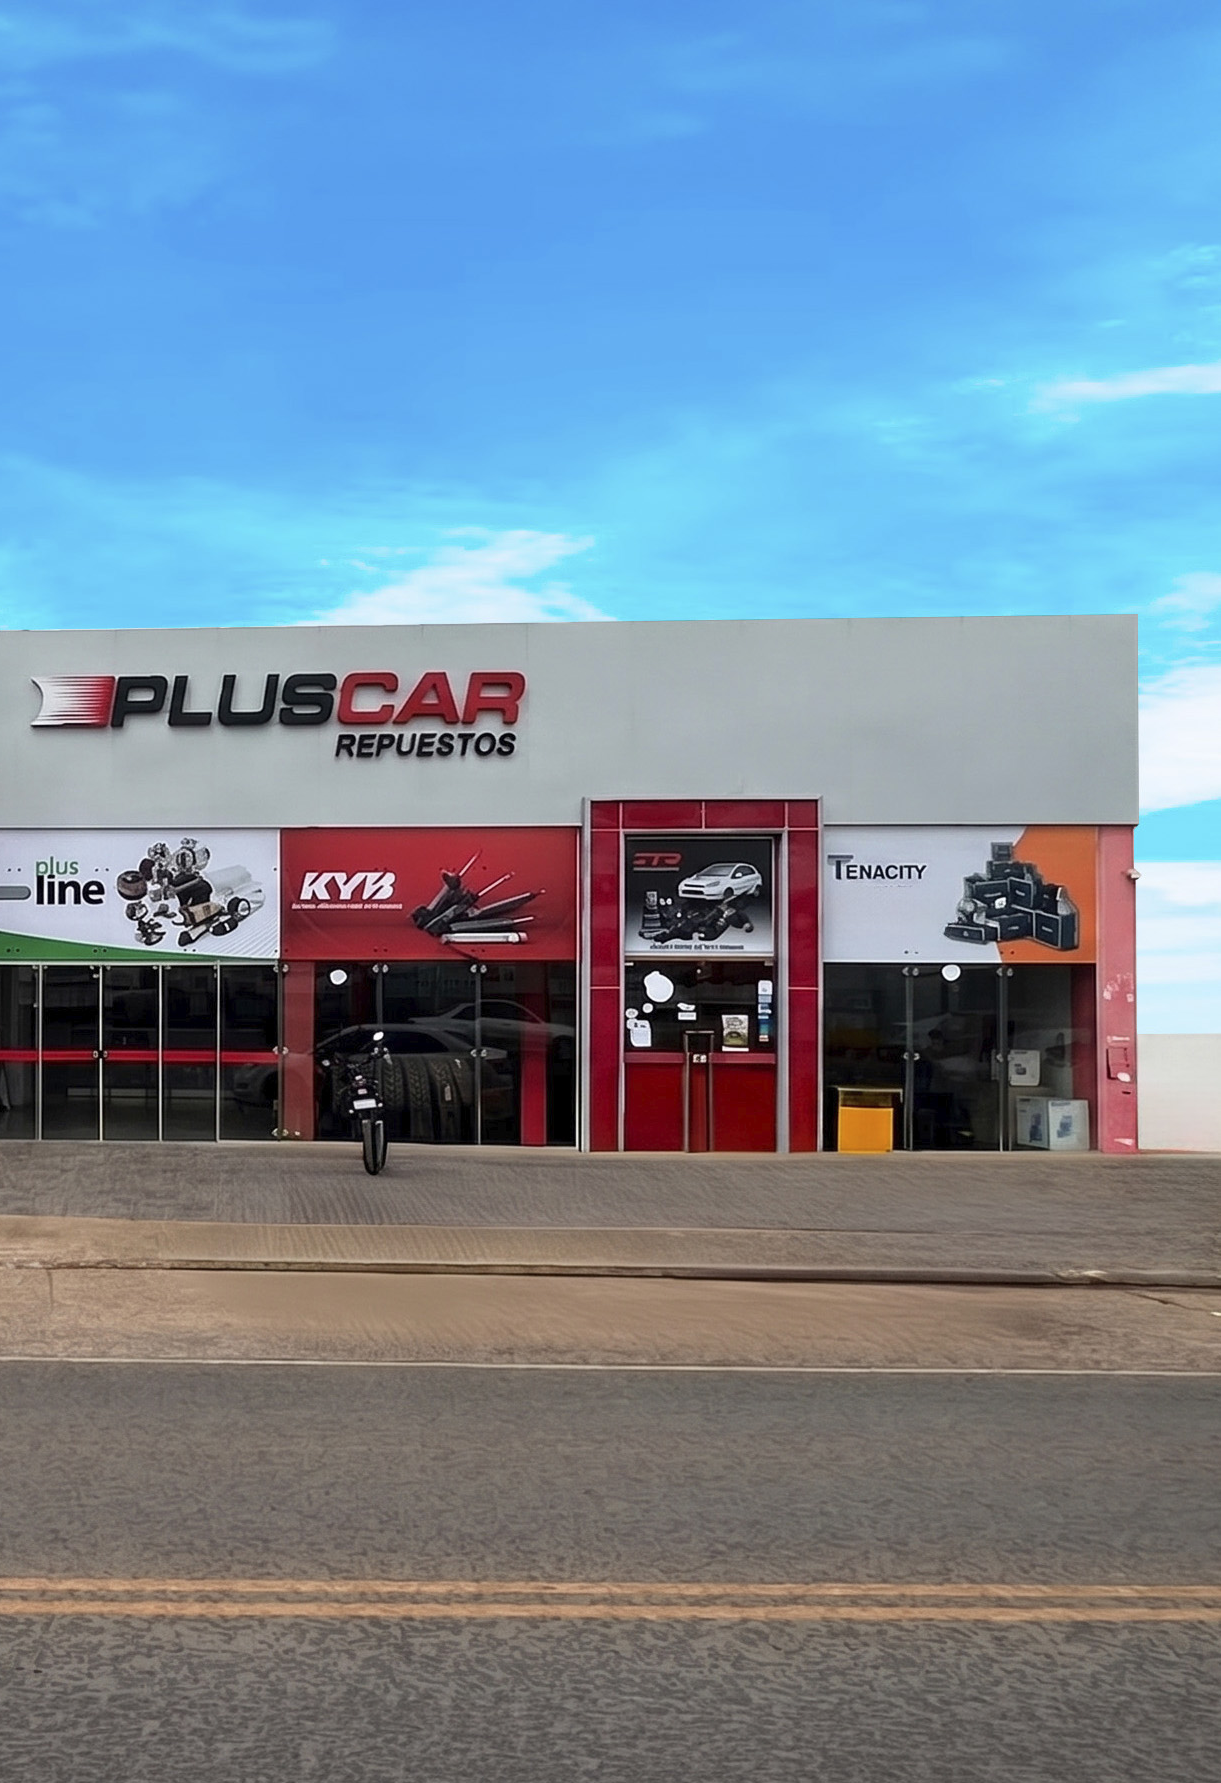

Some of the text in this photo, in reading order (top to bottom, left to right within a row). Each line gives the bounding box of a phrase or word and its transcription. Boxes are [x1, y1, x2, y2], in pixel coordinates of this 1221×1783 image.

[110, 671, 526, 728] PLUSCAR
[335, 732, 517, 758] REPUESTOS
[35, 856, 79, 876] plus
[827, 855, 927, 880] TENACITY
[36, 874, 106, 905] line
[299, 872, 396, 900] KYB
